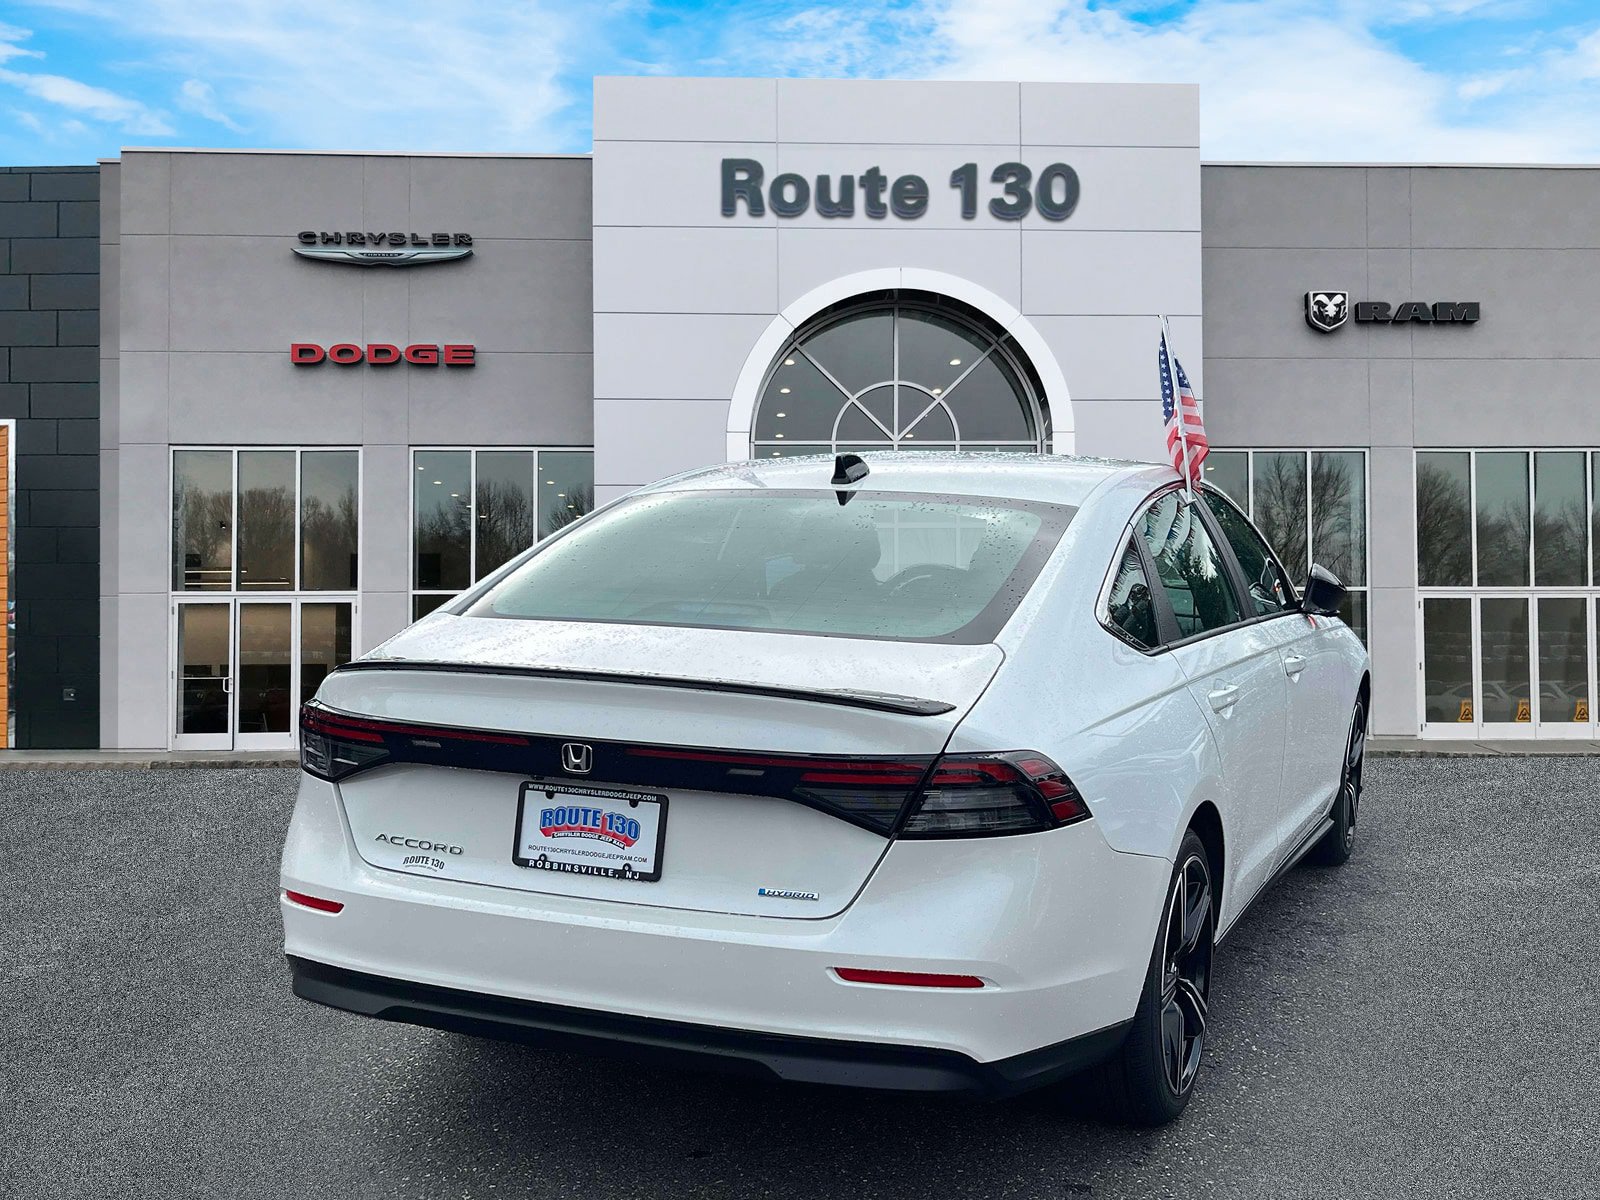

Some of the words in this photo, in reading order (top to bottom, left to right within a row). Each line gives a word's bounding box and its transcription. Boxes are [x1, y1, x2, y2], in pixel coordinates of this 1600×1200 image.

[721, 158, 929, 218] Route
[950, 162, 1080, 221] 130
[298, 231, 473, 246] CHRYSLER
[1355, 302, 1480, 325] RAM
[291, 343, 475, 366] DODGE
[528, 783, 657, 802] WWW.ROUTE130CHRYSLERDODGEJEEP.COM
[540, 806, 602, 829] ROUTE
[604, 812, 640, 841] 130
[375, 833, 464, 855] ACCORD
[528, 844, 648, 863] ROUTE130CHRYSLERDODGEJEEPRAM.COM
[612, 839, 625, 849] RAM
[403, 856, 430, 864] ROUTE
[431, 858, 445, 869] 130
[528, 860, 619, 878] ROBBINSVILLE,
[626, 870, 640, 880] NJ
[767, 889, 815, 898] HYBRID
